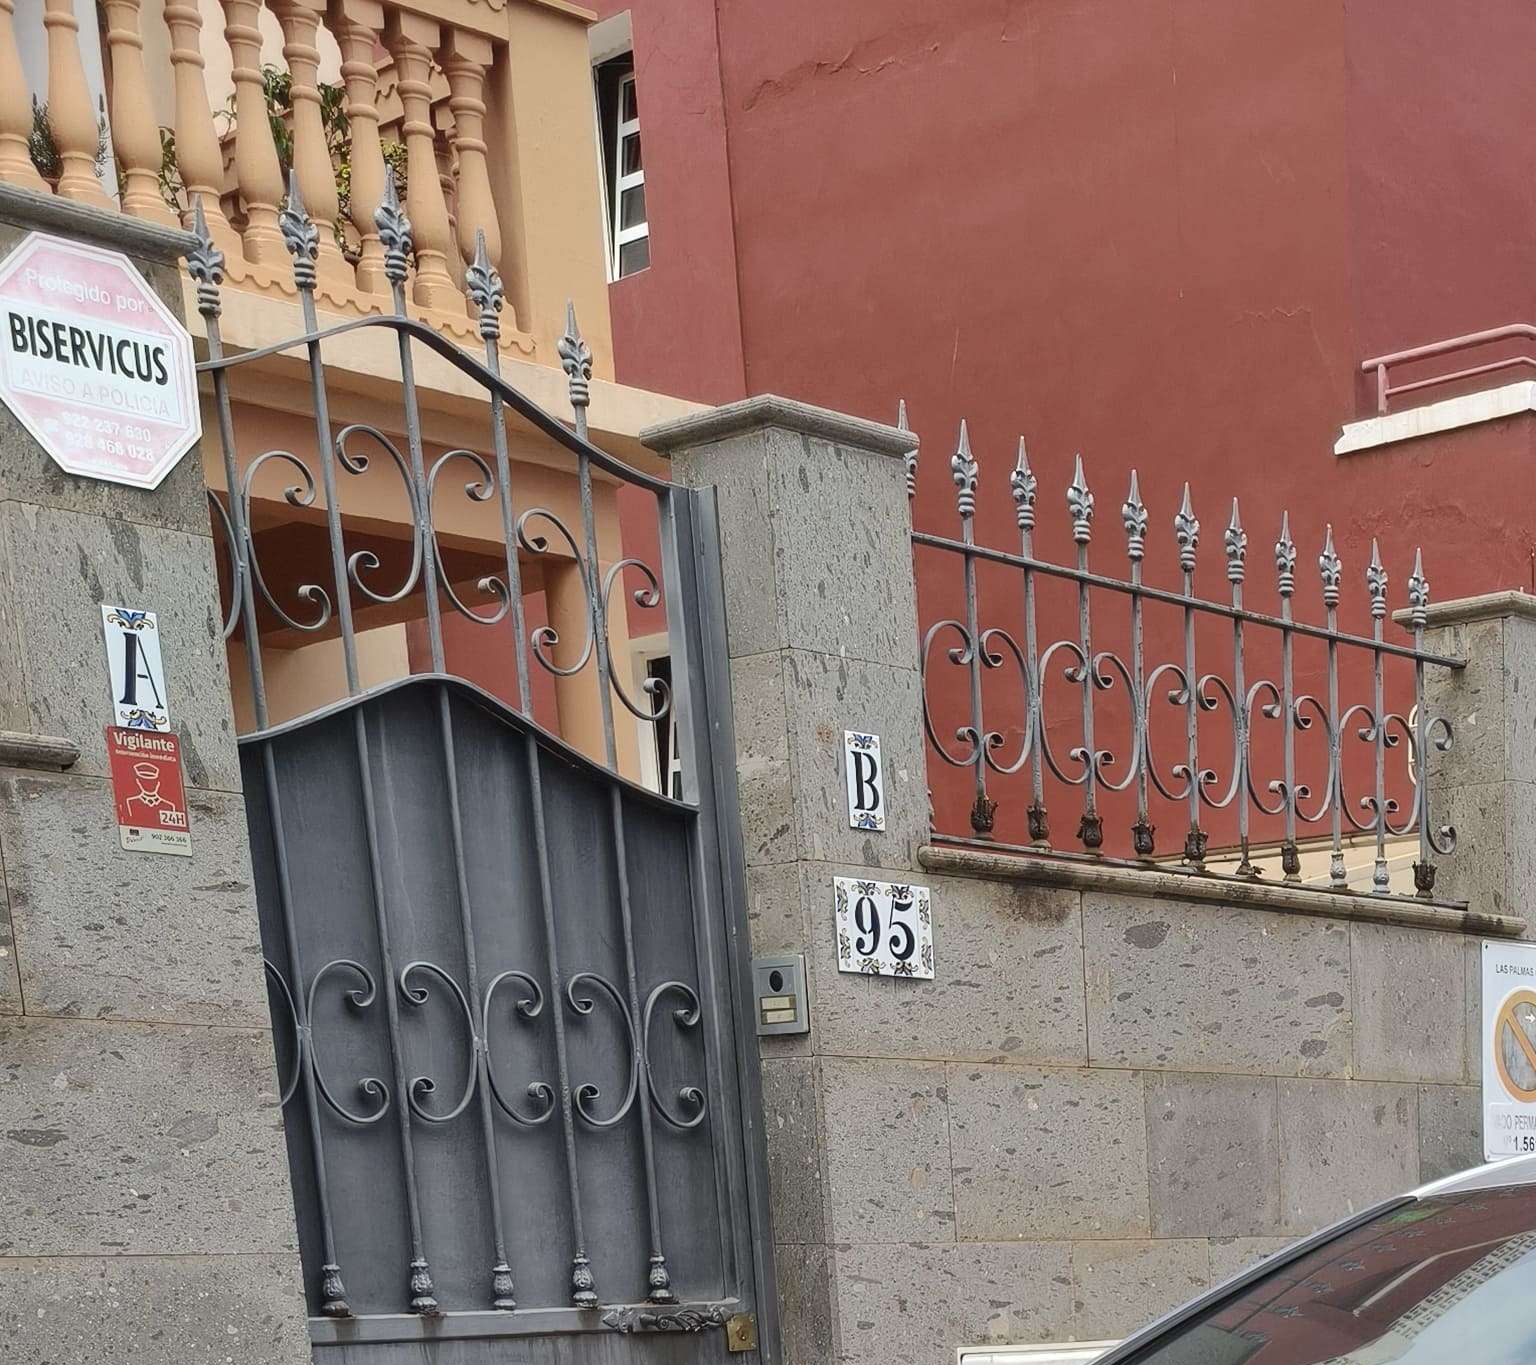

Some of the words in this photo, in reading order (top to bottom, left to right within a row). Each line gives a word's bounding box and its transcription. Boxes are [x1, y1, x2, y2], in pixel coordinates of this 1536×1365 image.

[24, 267, 111, 304] Protegido
[8, 311, 169, 387] BISERVICUS
[21, 369, 76, 396] AVISO
[119, 632, 164, 709] A
[113, 731, 175, 753] Vigilante
[850, 750, 879, 812] B
[161, 812, 185, 827] 24H
[854, 896, 916, 961] 95
[1495, 963, 1509, 975] LAS
[1509, 965, 1534, 977] PALMAS
